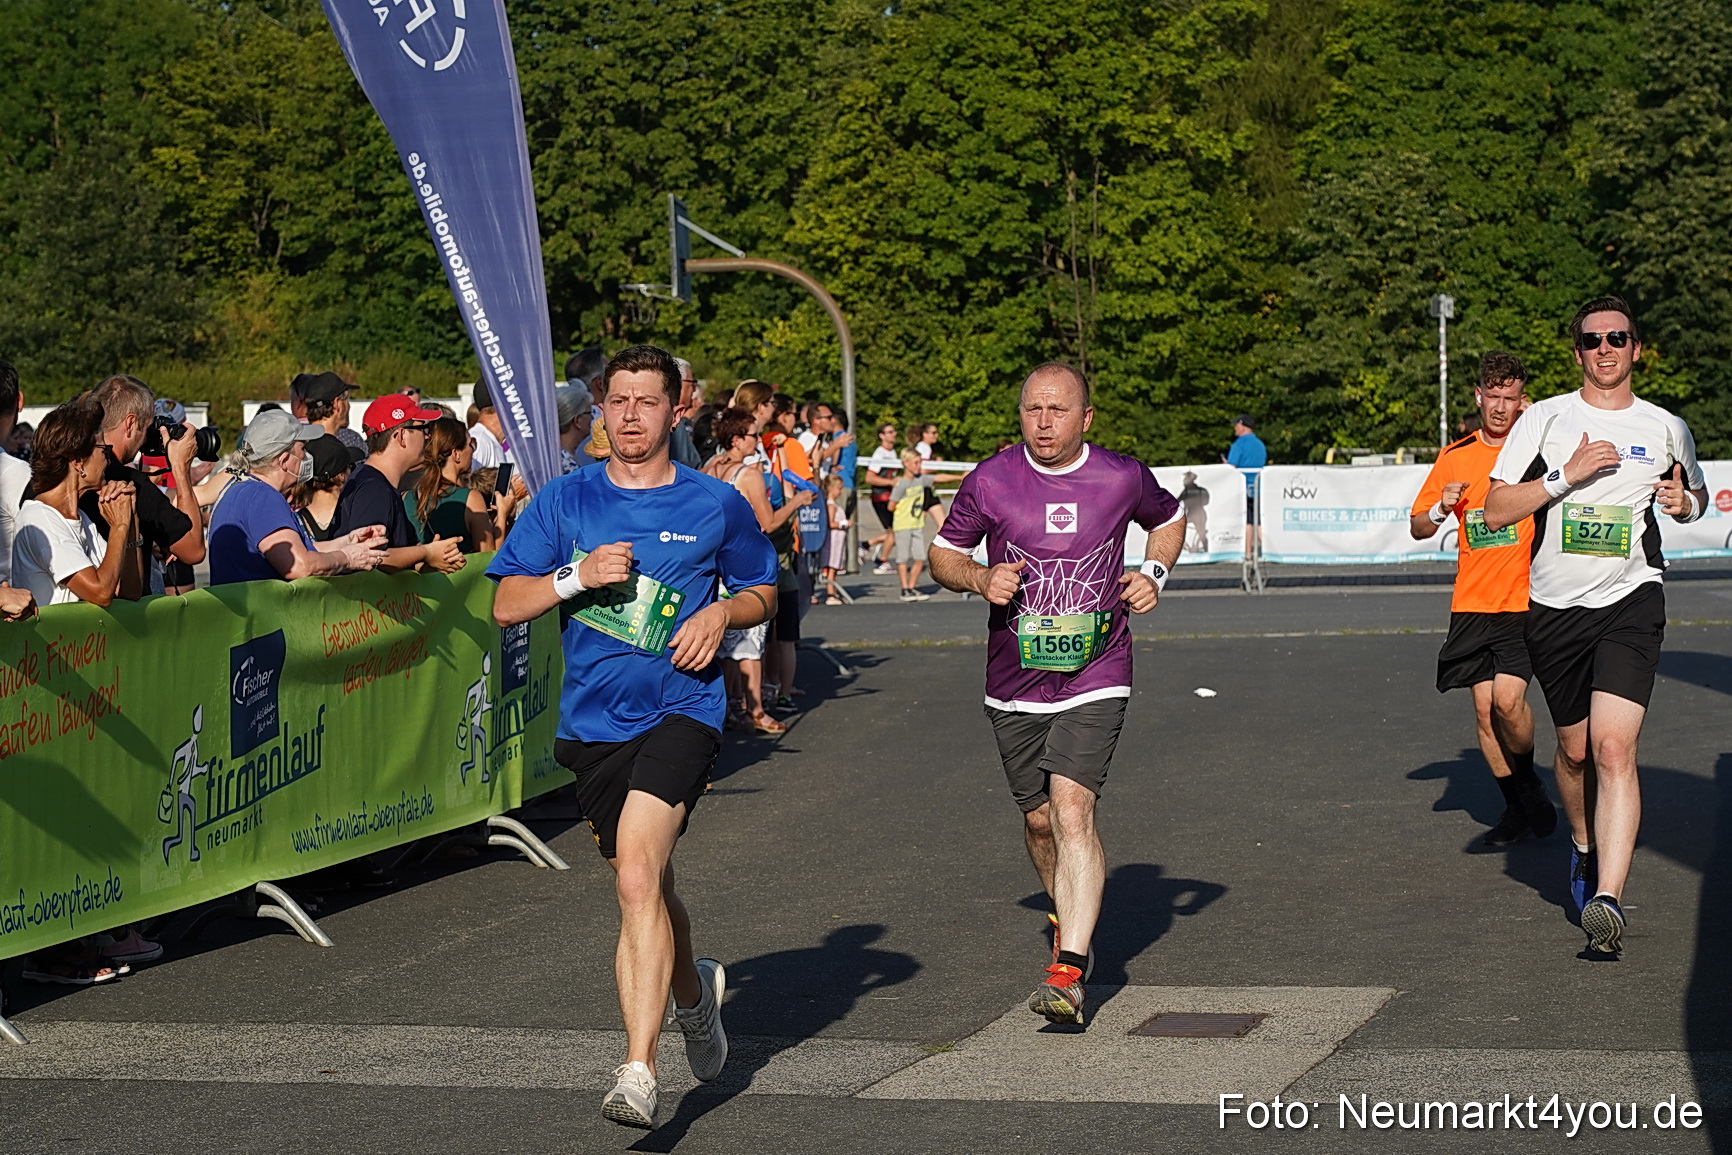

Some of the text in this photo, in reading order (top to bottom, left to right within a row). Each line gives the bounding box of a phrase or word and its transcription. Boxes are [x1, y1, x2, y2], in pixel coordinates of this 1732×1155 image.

[1283, 487, 1318, 499] NOW
[1285, 510, 1336, 521] E-BIKES
[1339, 509, 1349, 521] &
[1578, 521, 1614, 539] 527
[672, 532, 697, 543] Berger
[1621, 527, 1629, 550] 2022
[322, 592, 425, 658] Gesunde Firmen
[593, 608, 631, 629] Christoph
[628, 604, 647, 635] 2022
[46, 632, 106, 680] Firmen
[1023, 641, 1031, 659] RUN
[1032, 634, 1083, 653] 1566
[243, 668, 274, 698] Fischer
[343, 647, 383, 696] laufen
[57, 665, 121, 740] länger!
[206, 703, 325, 821] firmenlauf
[207, 803, 263, 850] neumarkt
[291, 784, 435, 854] www.firmenlauf-oberpfalz.de
